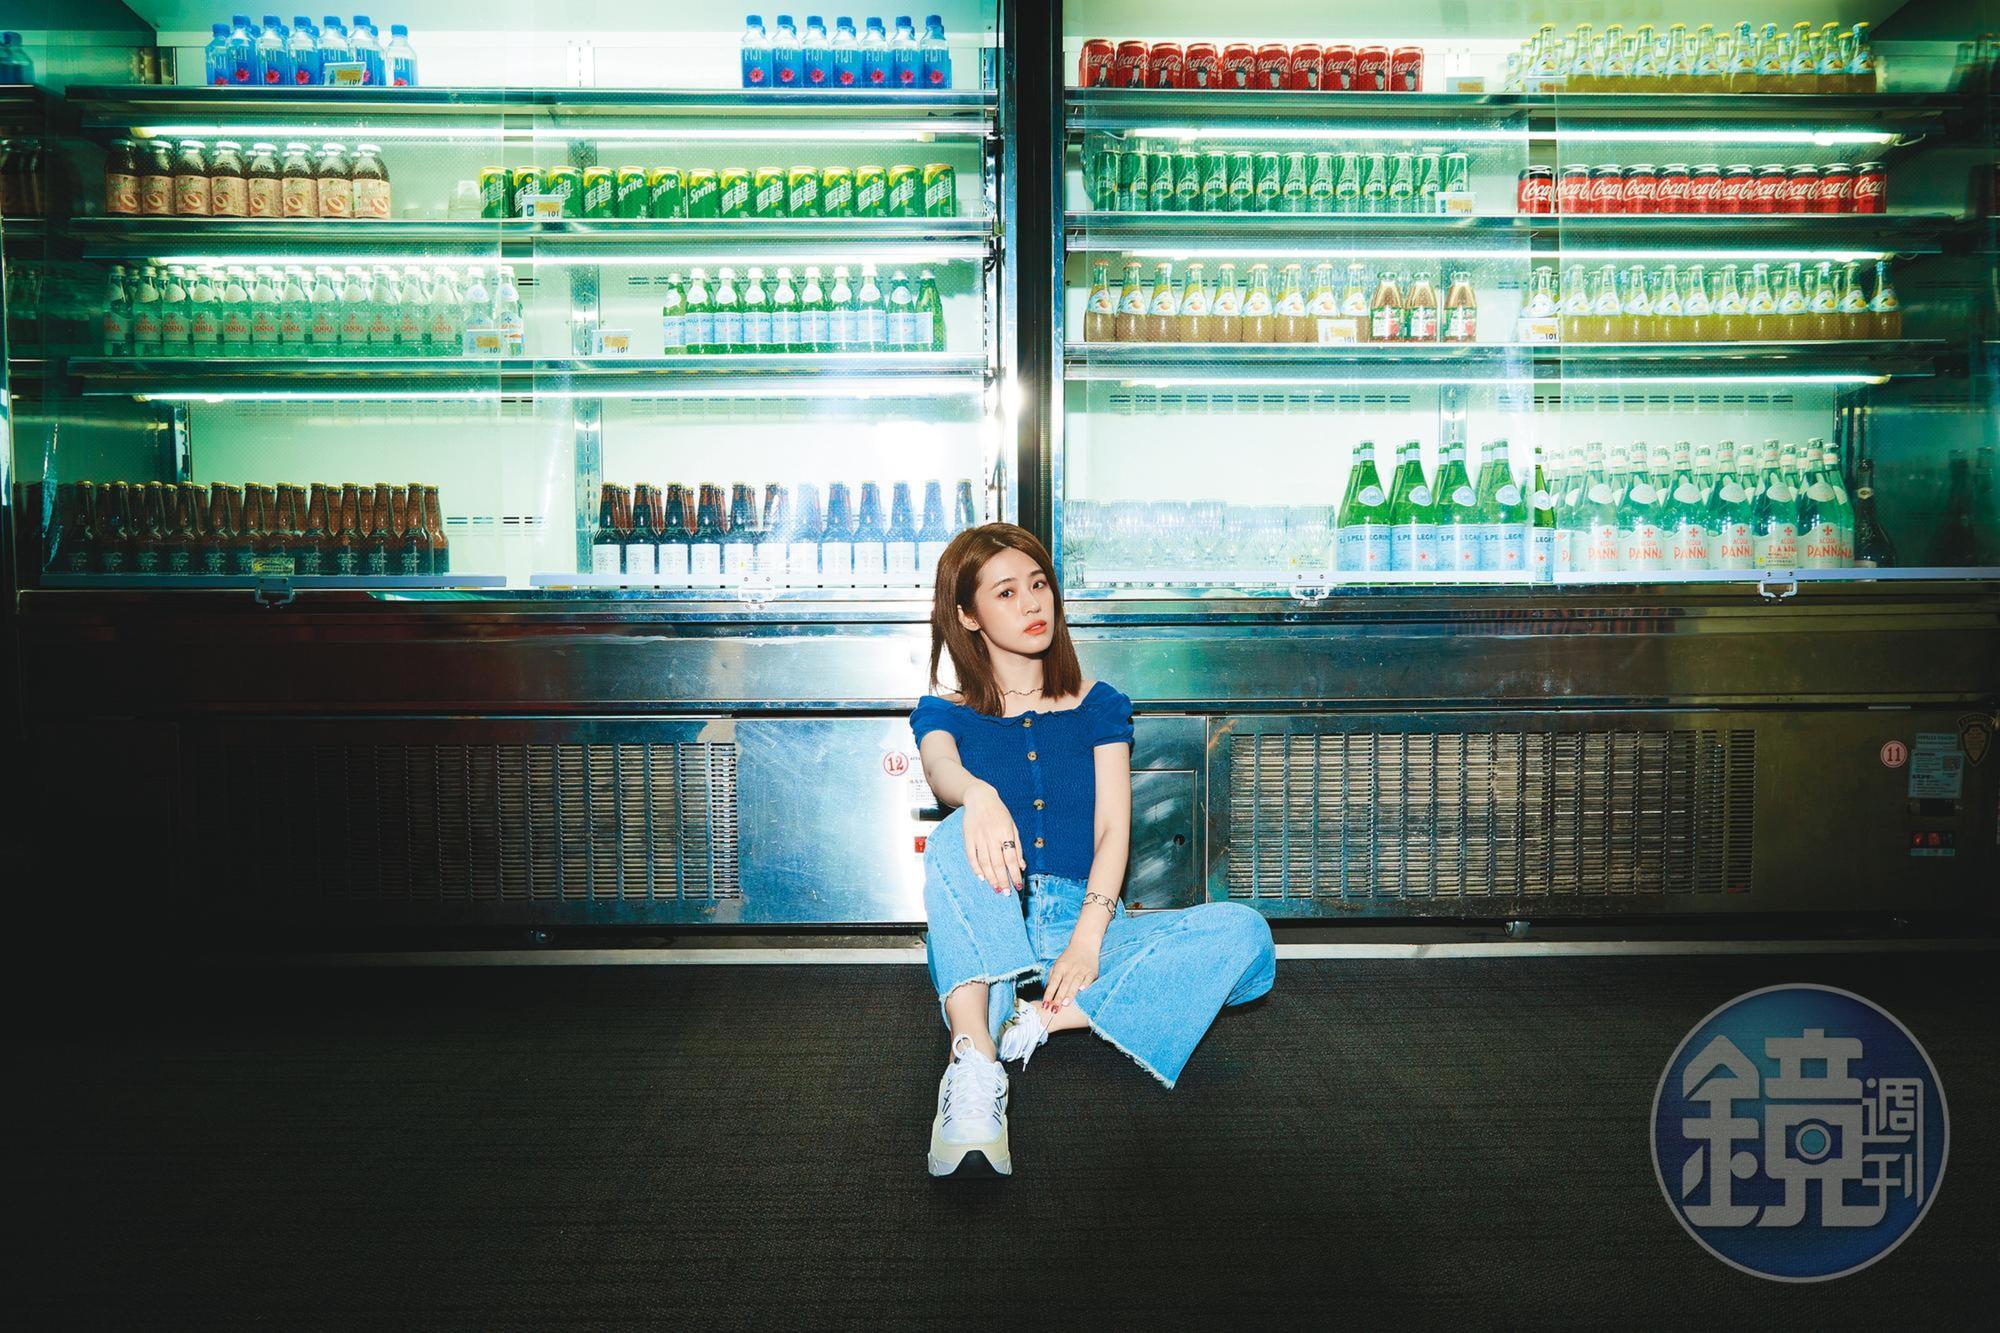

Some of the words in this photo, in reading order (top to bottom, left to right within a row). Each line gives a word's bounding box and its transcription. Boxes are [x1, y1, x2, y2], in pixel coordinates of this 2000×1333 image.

[322, 50, 341, 61] FIJI
[744, 49, 762, 60] FIJI
[775, 49, 793, 60] FIJI
[805, 49, 823, 60] FIJI
[835, 50, 853, 63] FIJI
[866, 48, 884, 62] FIJI
[895, 48, 913, 62] FIJI
[924, 49, 942, 62] FIJI
[618, 177, 643, 202] Sprite
[652, 178, 676, 203] Sprite
[690, 180, 716, 205] Sprite
[1887, 746, 1901, 761] 11
[888, 756, 904, 771] 12
